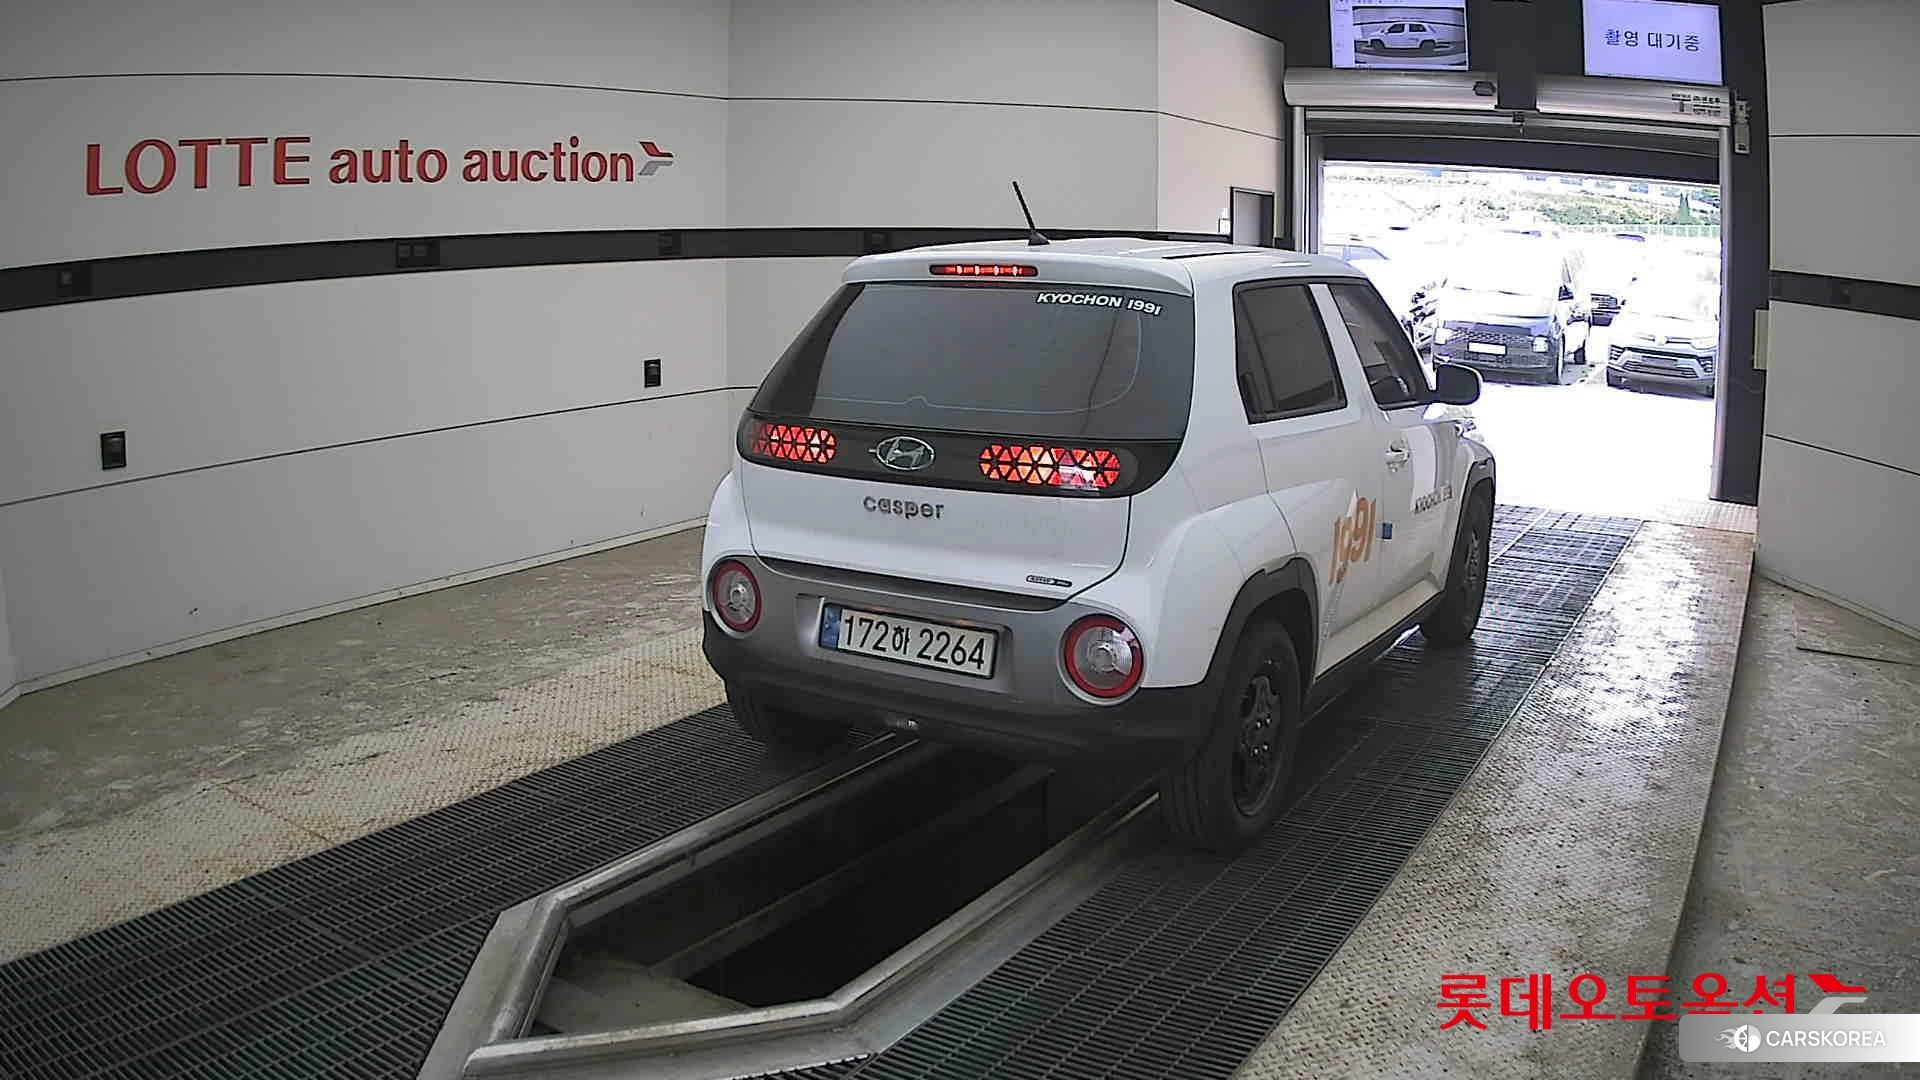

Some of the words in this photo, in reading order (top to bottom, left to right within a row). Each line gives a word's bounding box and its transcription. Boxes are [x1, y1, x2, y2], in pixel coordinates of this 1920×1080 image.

[1605, 29, 1639, 47] 촬영
[1647, 32, 1699, 51] 대기중
[86, 136, 310, 195] LOTTE
[329, 140, 447, 184] auto
[463, 135, 634, 183] auction
[1036, 291, 1122, 309] KYOCHON
[1127, 298, 1162, 316] 1991
[863, 496, 945, 519] casper
[844, 615, 912, 656] 172하
[917, 628, 985, 671] 2264
